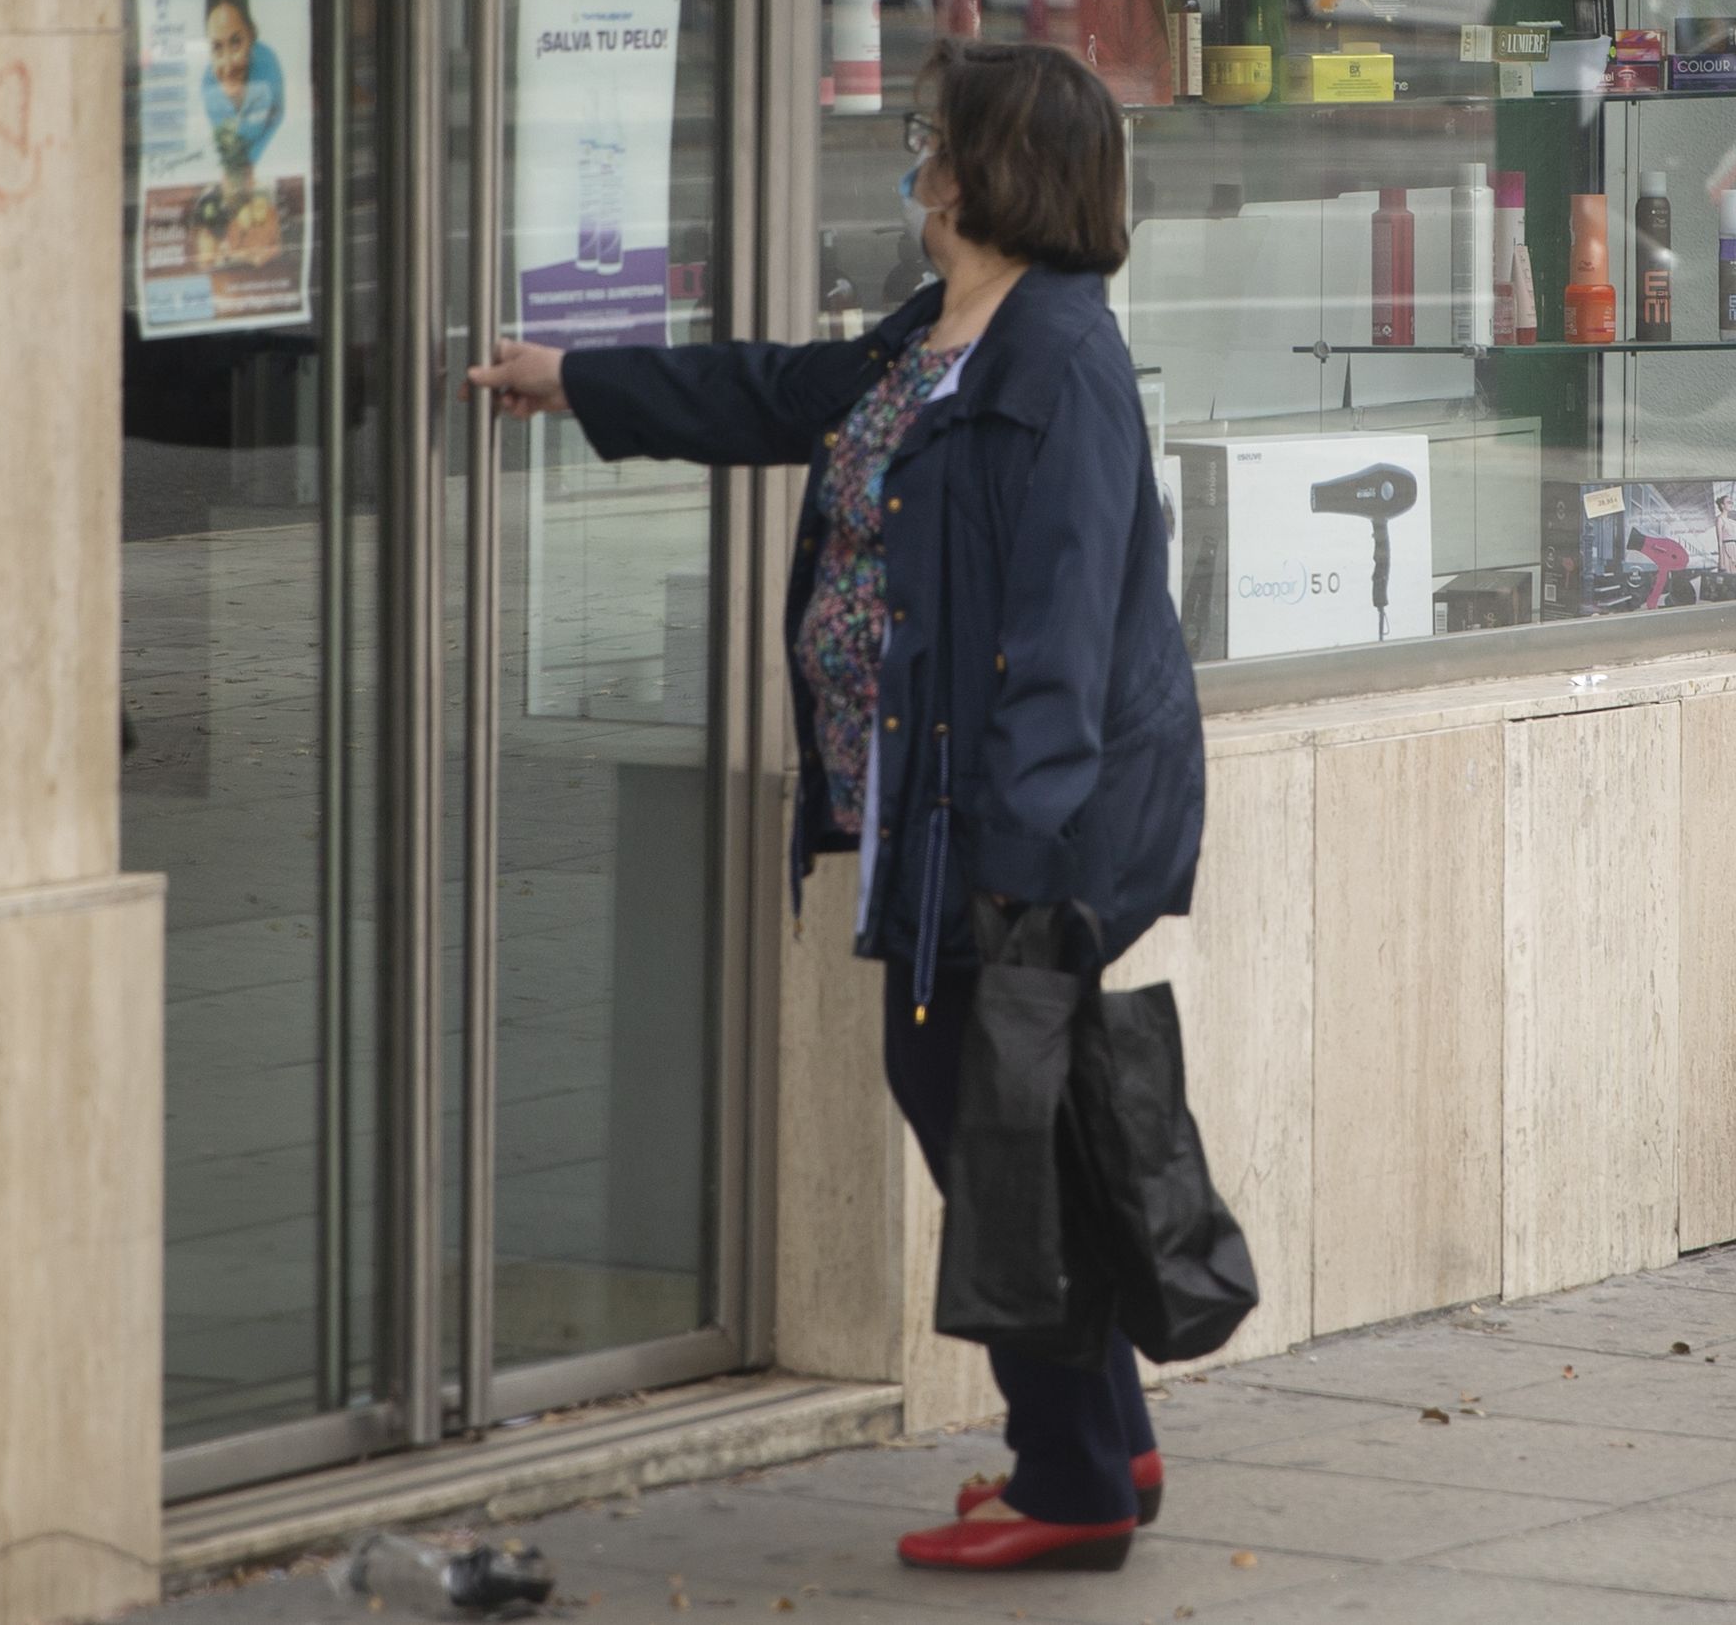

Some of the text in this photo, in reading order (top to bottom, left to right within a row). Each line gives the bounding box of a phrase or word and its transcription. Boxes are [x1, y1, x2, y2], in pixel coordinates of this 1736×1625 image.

[537, 28, 668, 60] ¡SALVA TU PELO!
[1507, 29, 1545, 53] LUMIÈRE
[1677, 60, 1731, 73] COLOUR
